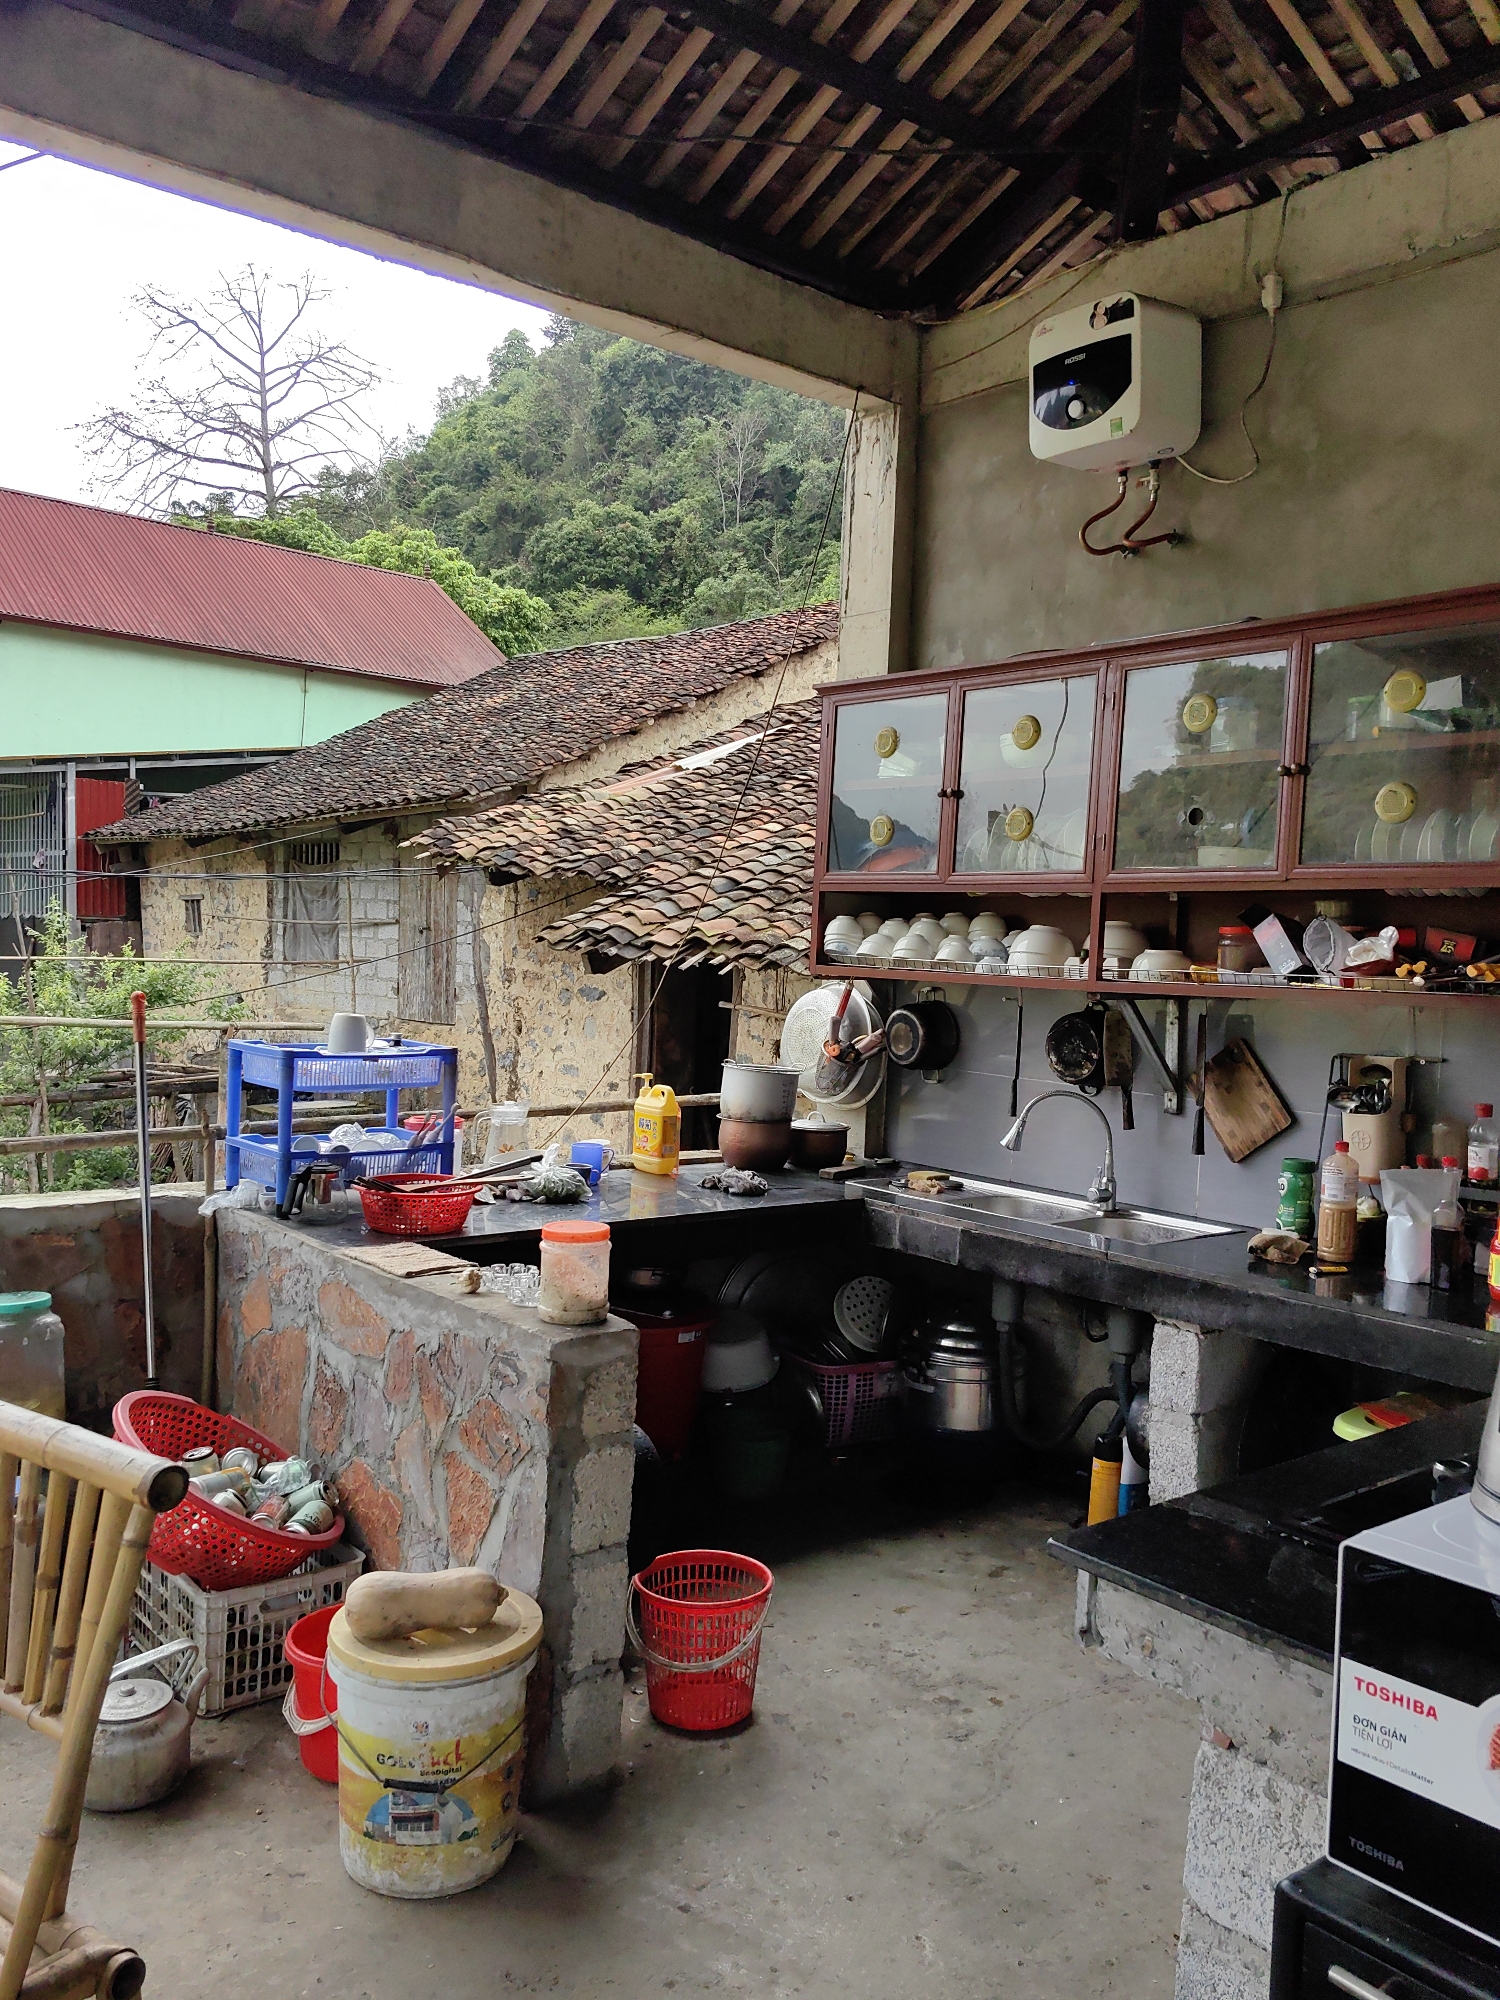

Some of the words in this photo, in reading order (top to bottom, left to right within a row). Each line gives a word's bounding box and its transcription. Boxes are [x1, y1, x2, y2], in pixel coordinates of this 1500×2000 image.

[1064, 353, 1086, 365] ROSSI
[1354, 1675, 1438, 1721] TOSHIBA
[1353, 1714, 1377, 1732] ĐƠN
[1380, 1725, 1407, 1744] GIẢN
[1349, 1835, 1404, 1871] TOSHIBA
